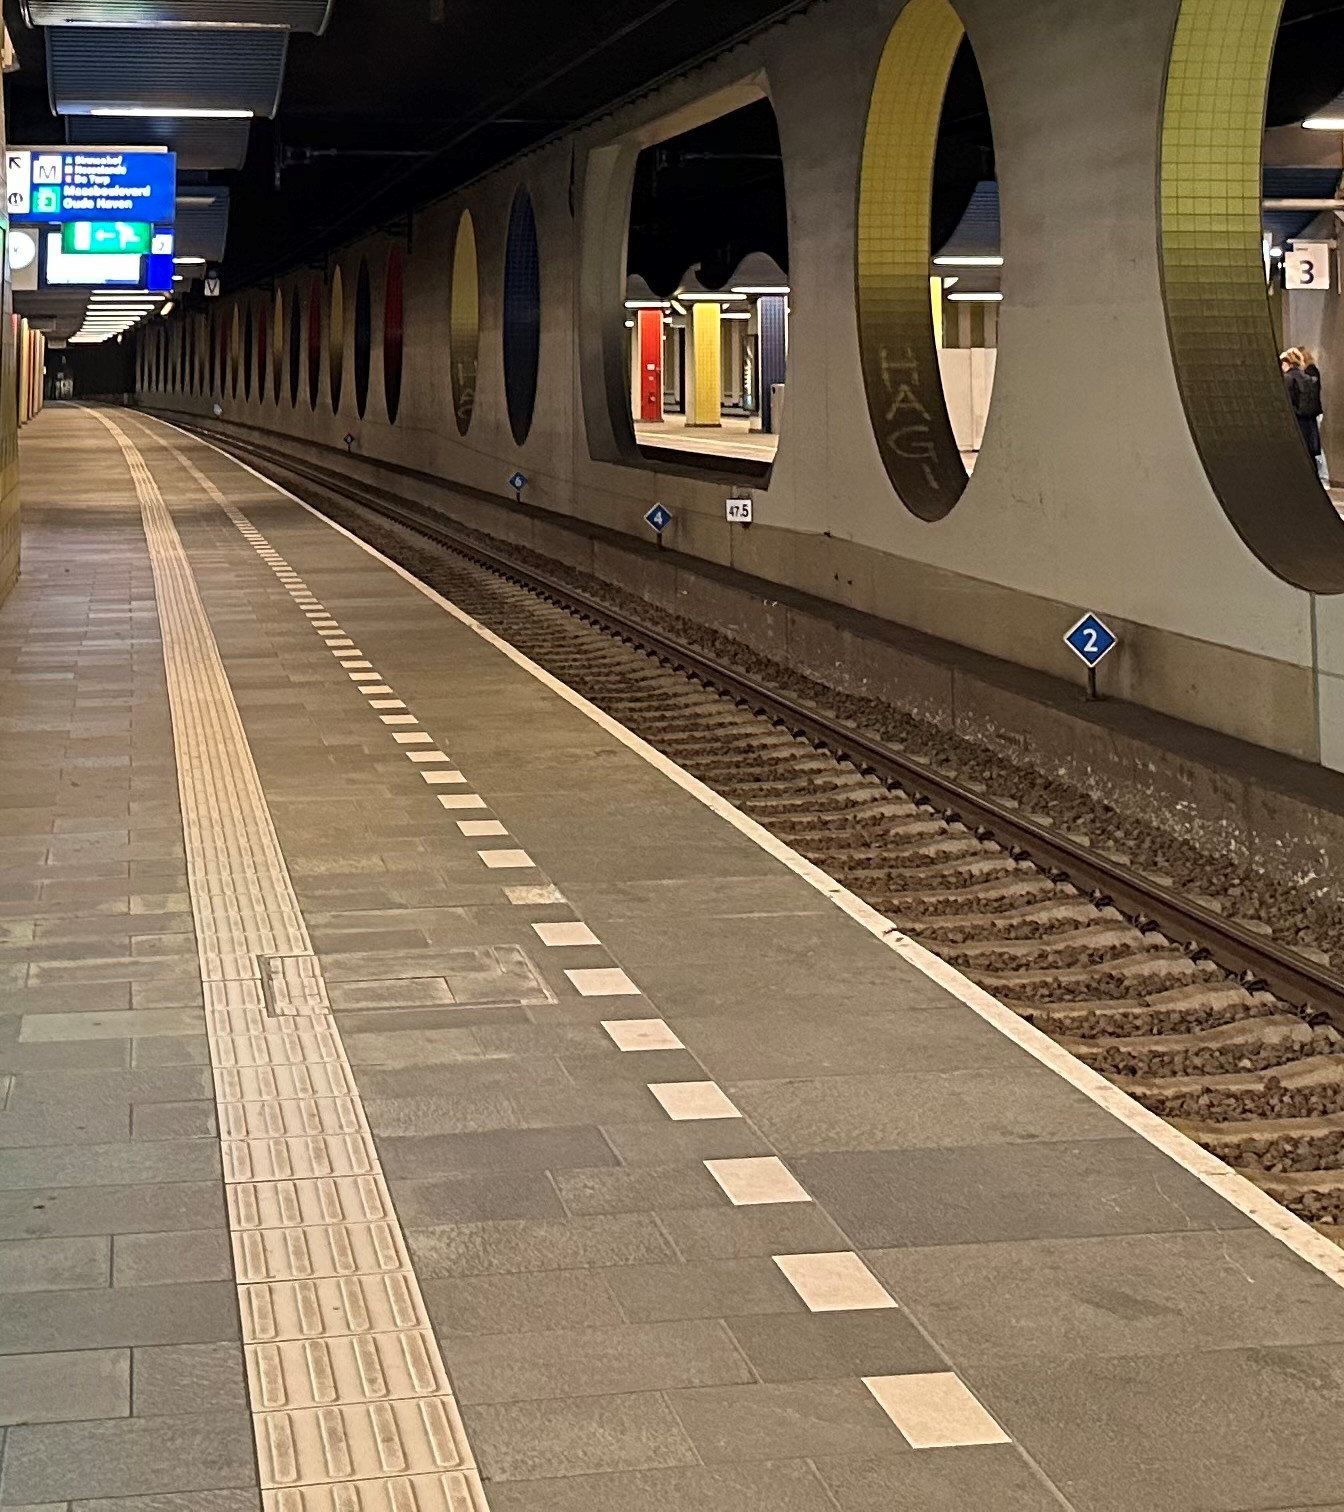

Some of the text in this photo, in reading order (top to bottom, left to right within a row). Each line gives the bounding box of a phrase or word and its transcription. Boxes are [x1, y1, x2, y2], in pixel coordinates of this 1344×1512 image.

[39, 165, 57, 179] M
[1300, 260, 1314, 284] 3
[653, 511, 664, 525] 4
[1083, 628, 1098, 652] 2
